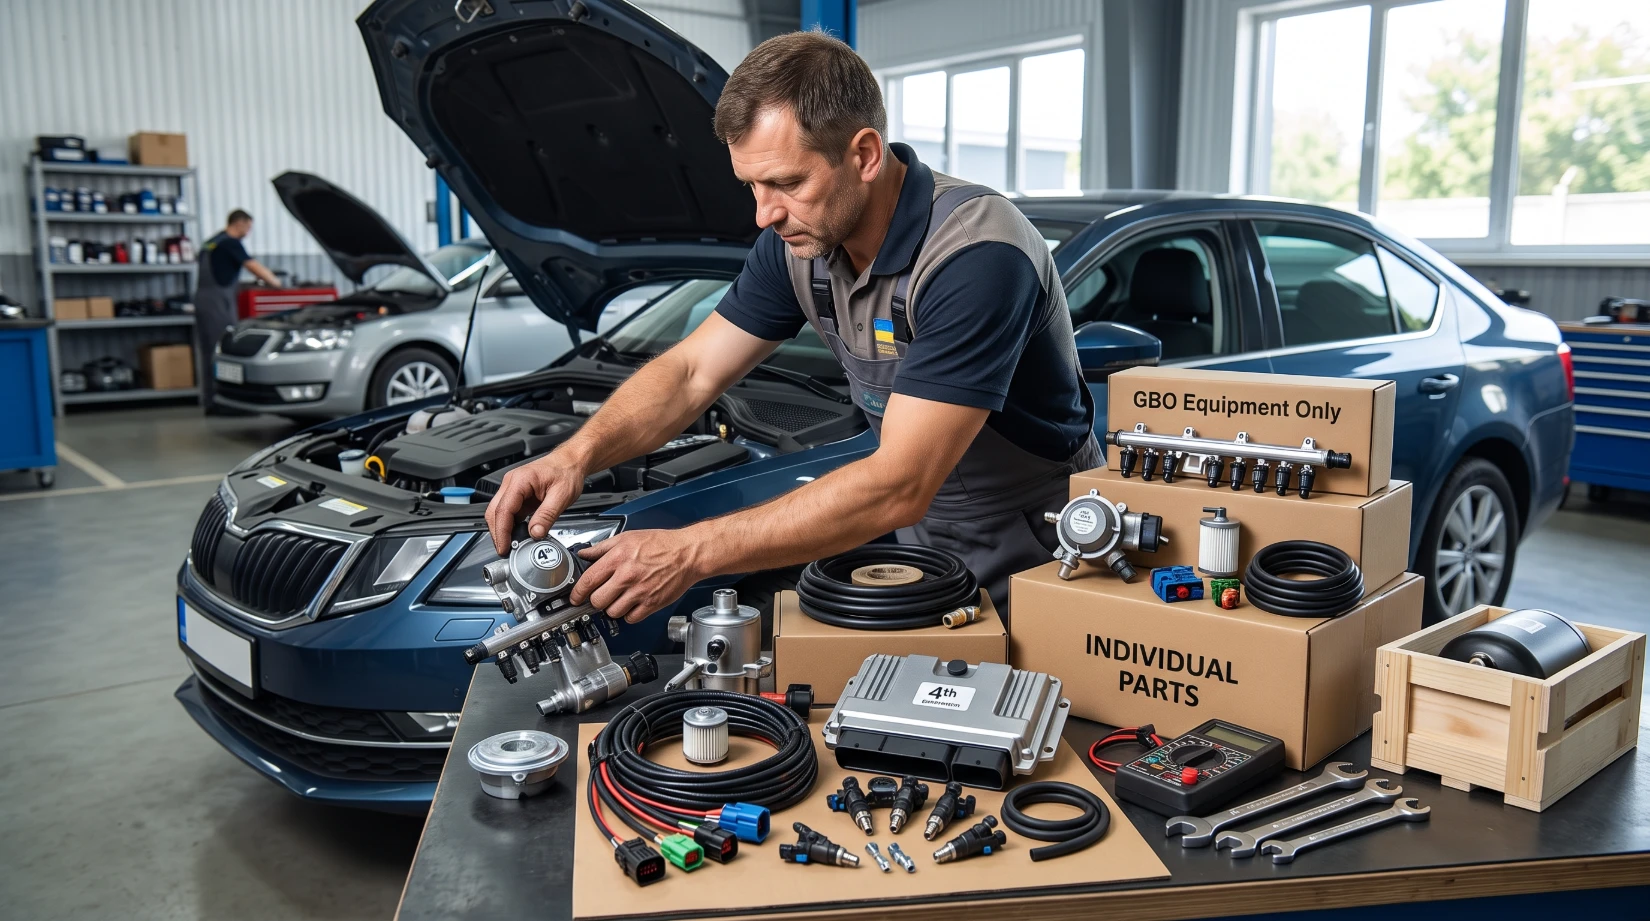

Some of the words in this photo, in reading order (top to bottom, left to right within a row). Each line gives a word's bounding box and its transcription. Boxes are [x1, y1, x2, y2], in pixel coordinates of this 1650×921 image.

[1133, 390, 1177, 410] GBO
[1183, 393, 1290, 418] Equipment
[1295, 400, 1342, 425] Only
[1086, 633, 1239, 685] INDIVIDUAL
[928, 686, 957, 700] 4th
[1119, 670, 1199, 707] PARTS
